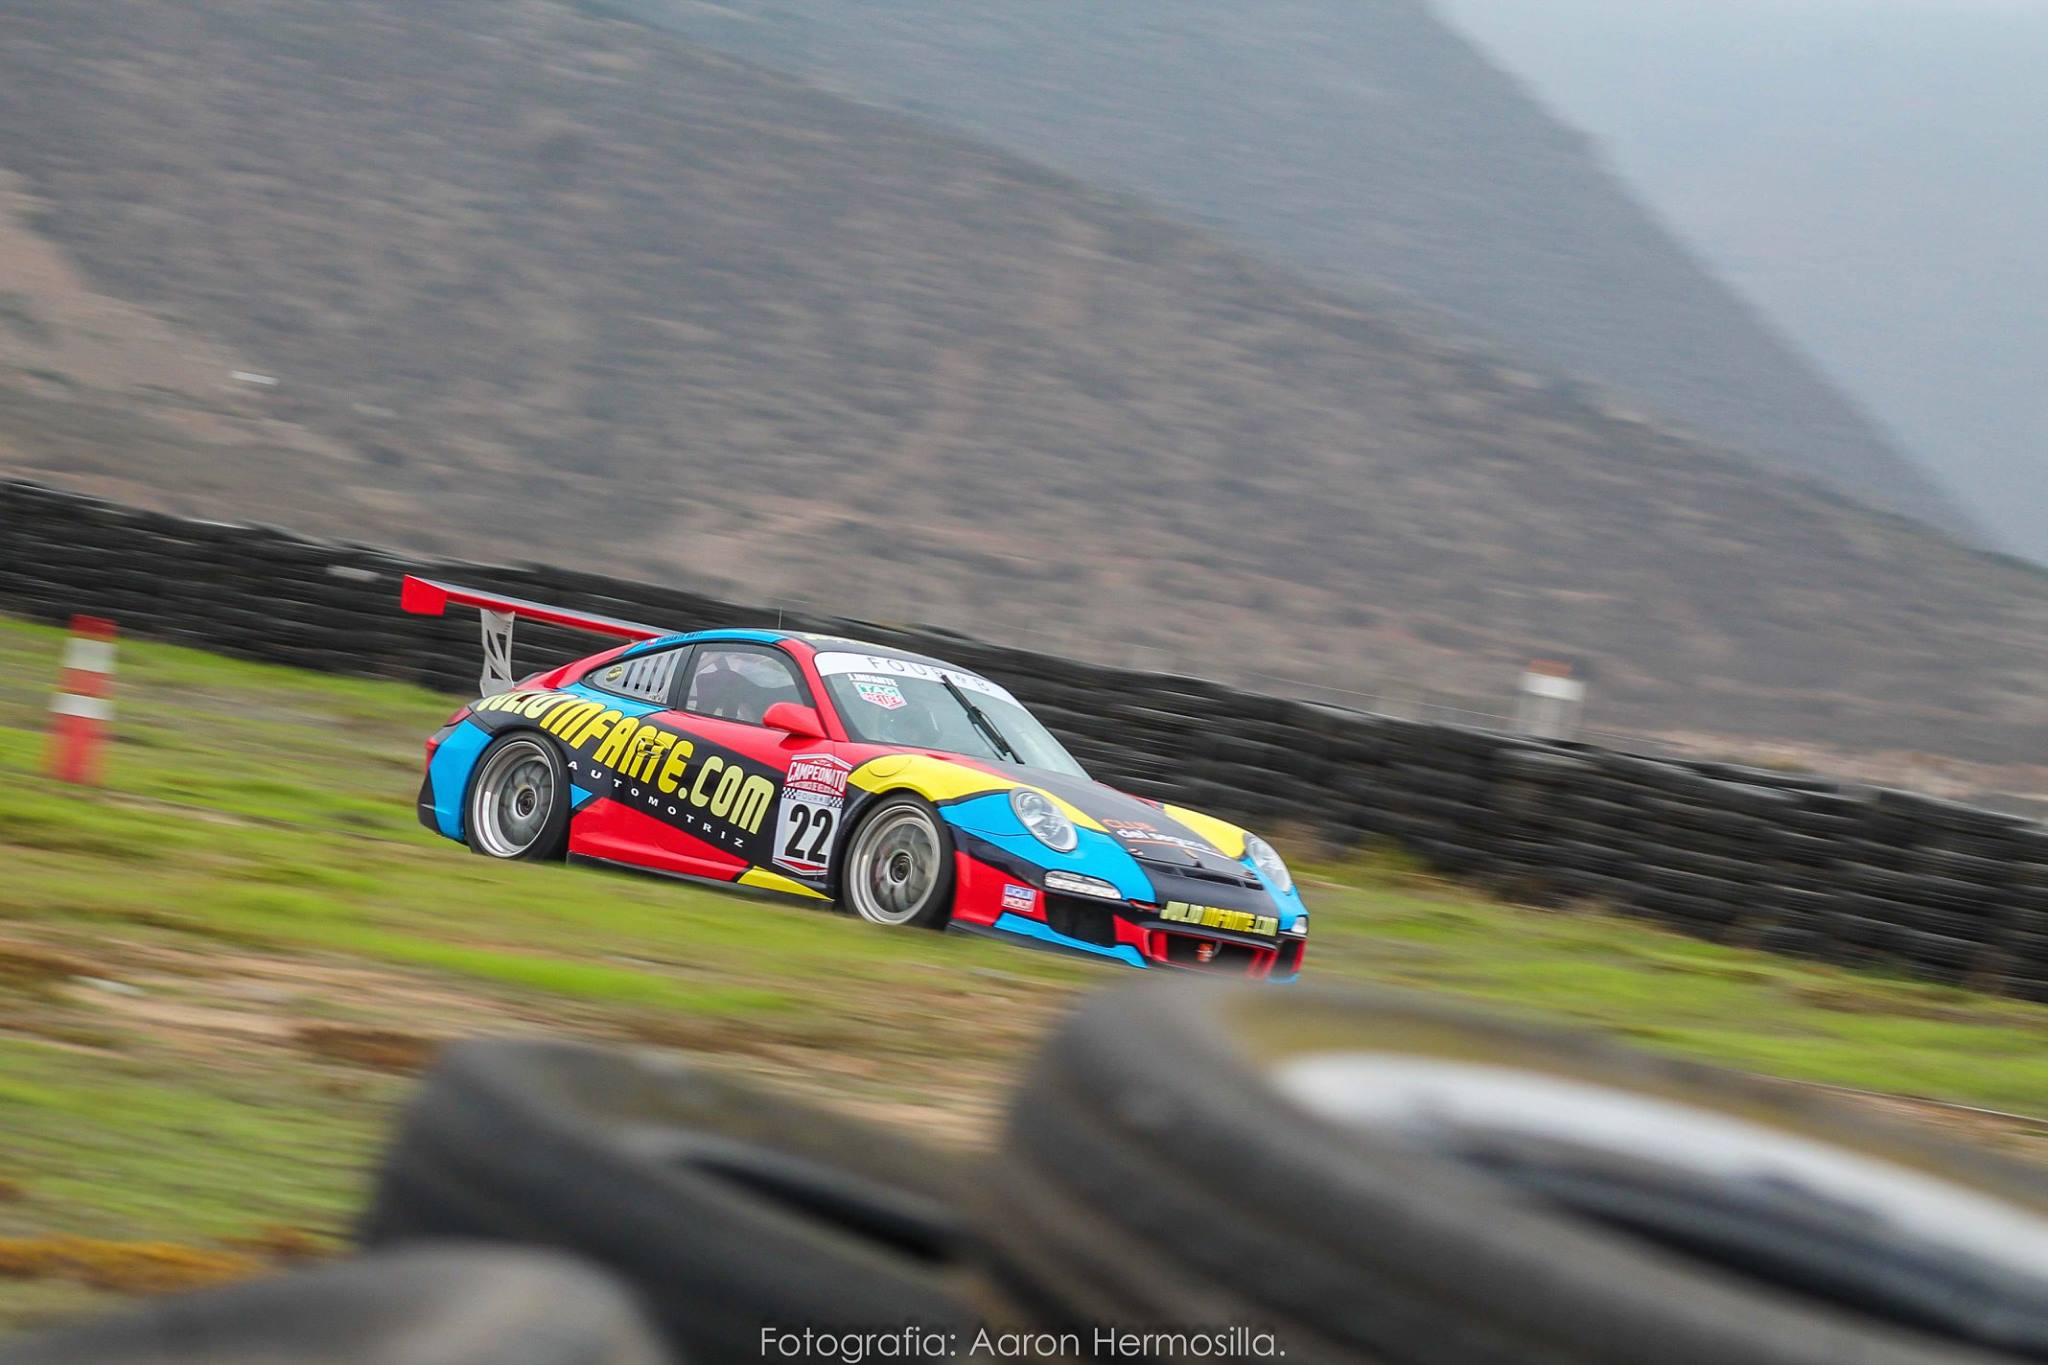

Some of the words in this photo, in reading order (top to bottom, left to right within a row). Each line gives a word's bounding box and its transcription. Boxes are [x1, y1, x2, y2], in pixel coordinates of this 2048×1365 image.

[567, 760, 745, 848] AUTOMOTRIZ
[787, 762, 848, 793] CAMPEONATO
[784, 803, 833, 864] 22
